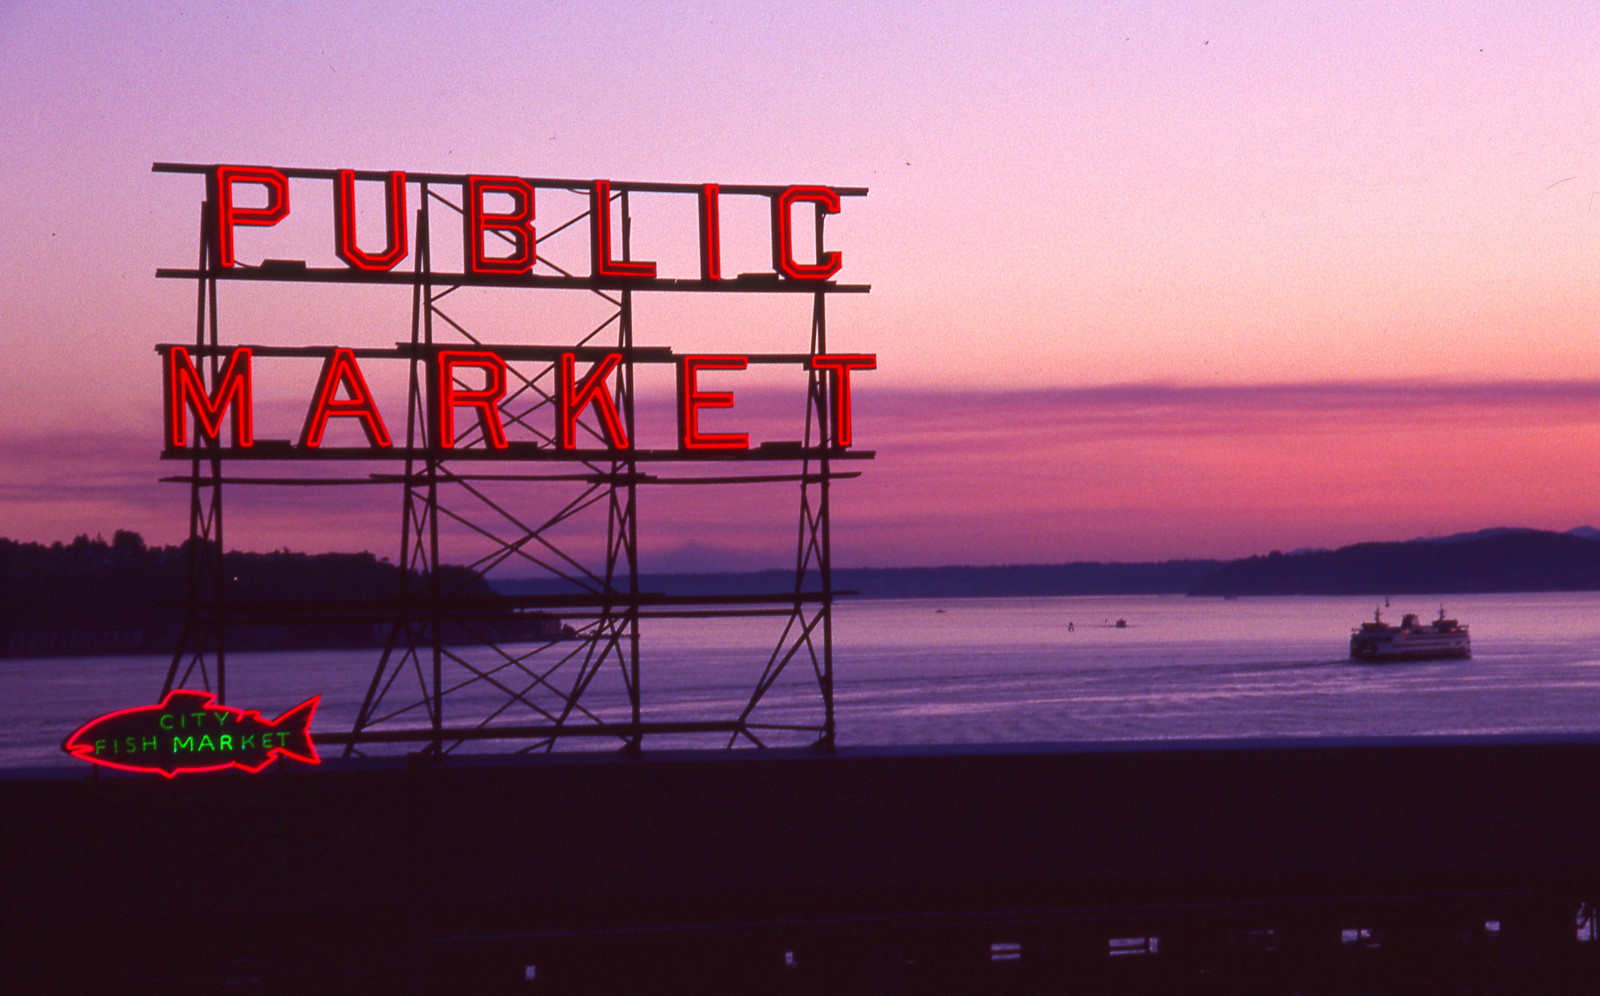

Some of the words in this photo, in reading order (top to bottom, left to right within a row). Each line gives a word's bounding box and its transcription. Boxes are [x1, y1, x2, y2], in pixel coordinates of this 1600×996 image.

[214, 164, 843, 281] PUBLIC
[169, 345, 878, 450] MARKET
[95, 735, 157, 755] FISH
[173, 731, 291, 754] MARKET
[159, 711, 230, 730] CITY
